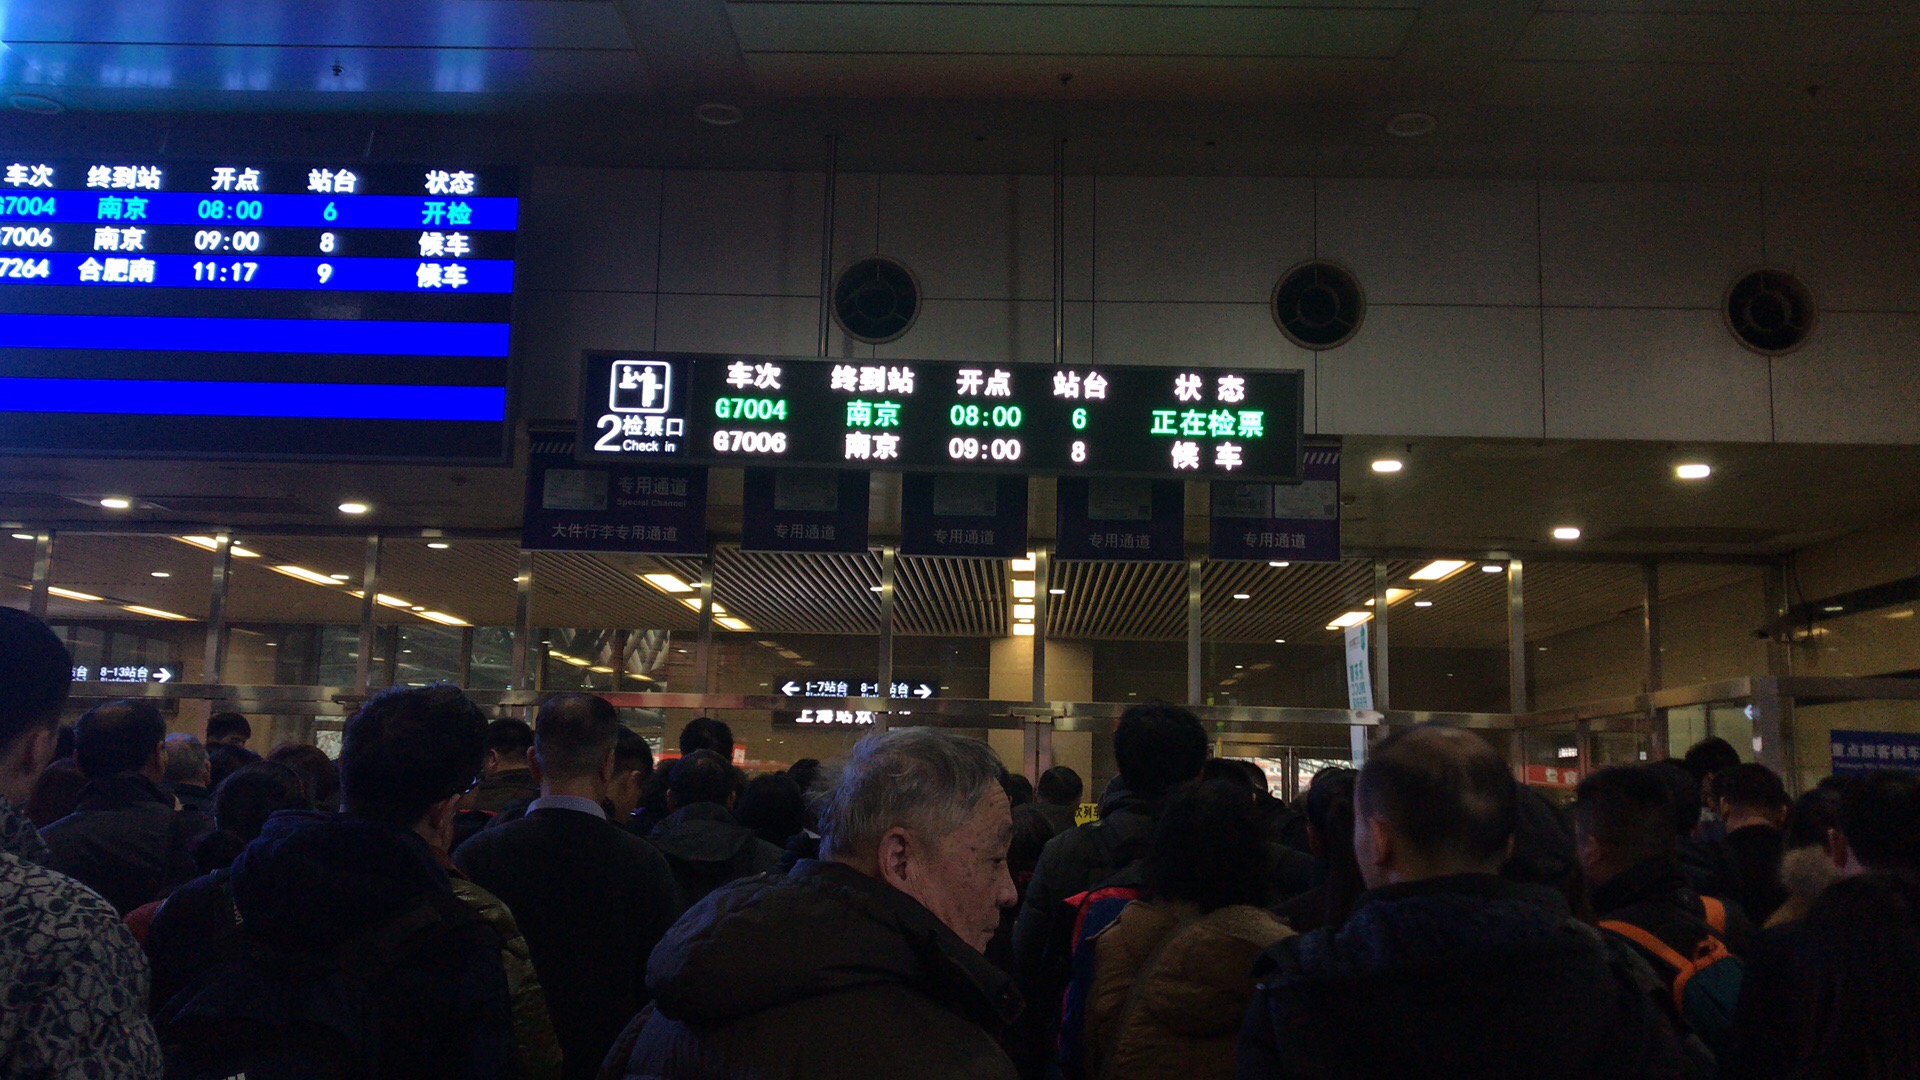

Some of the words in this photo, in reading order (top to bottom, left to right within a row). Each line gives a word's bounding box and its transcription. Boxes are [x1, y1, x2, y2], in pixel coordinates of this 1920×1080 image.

[4, 163, 53, 187] 车次
[87, 165, 162, 189] 终到站
[211, 167, 260, 191] 开点
[308, 169, 357, 193] 站台
[425, 170, 474, 194] 状态
[98, 196, 148, 220] 南京
[198, 200, 262, 219] 08:00
[324, 202, 337, 220] 6
[422, 202, 472, 225] 开检
[0, 227, 53, 247] 7006
[94, 226, 146, 251] 南京
[195, 231, 260, 251] 09:00
[320, 233, 334, 252] 8
[419, 232, 470, 257] 候车
[78, 257, 155, 282] 合肥南
[194, 262, 258, 281] 11:17
[318, 264, 332, 283] 9
[416, 263, 468, 288] 候车
[726, 361, 781, 389] 车次
[831, 365, 915, 393] 终到站
[956, 369, 1010, 396] 开点
[1053, 371, 1108, 399] 站台
[715, 398, 787, 420] G7004
[847, 399, 901, 427] 南京
[950, 405, 1022, 427] 08:00
[1072, 408, 1086, 429] 6
[1151, 409, 1264, 438] 正在检票
[594, 414, 621, 452] 2
[622, 415, 684, 438] 检票口
[622, 439, 659, 453] Check
[664, 440, 676, 453] in
[713, 430, 786, 453] G7006
[845, 431, 900, 459] 南京
[949, 438, 1021, 460] 09:00
[1071, 441, 1085, 462] 8
[617, 476, 689, 497] 专用通道
[616, 498, 649, 508] Special
[651, 499, 688, 508] Channel
[551, 522, 678, 542] 大件行李专用通道
[774, 523, 836, 540] 专用通道
[933, 528, 995, 546] 专用通道
[1088, 531, 1151, 549] 专用通道
[1243, 531, 1307, 549] 专用通道
[99, 666, 149, 679] 8-13站台
[805, 681, 848, 694] 1-7站台
